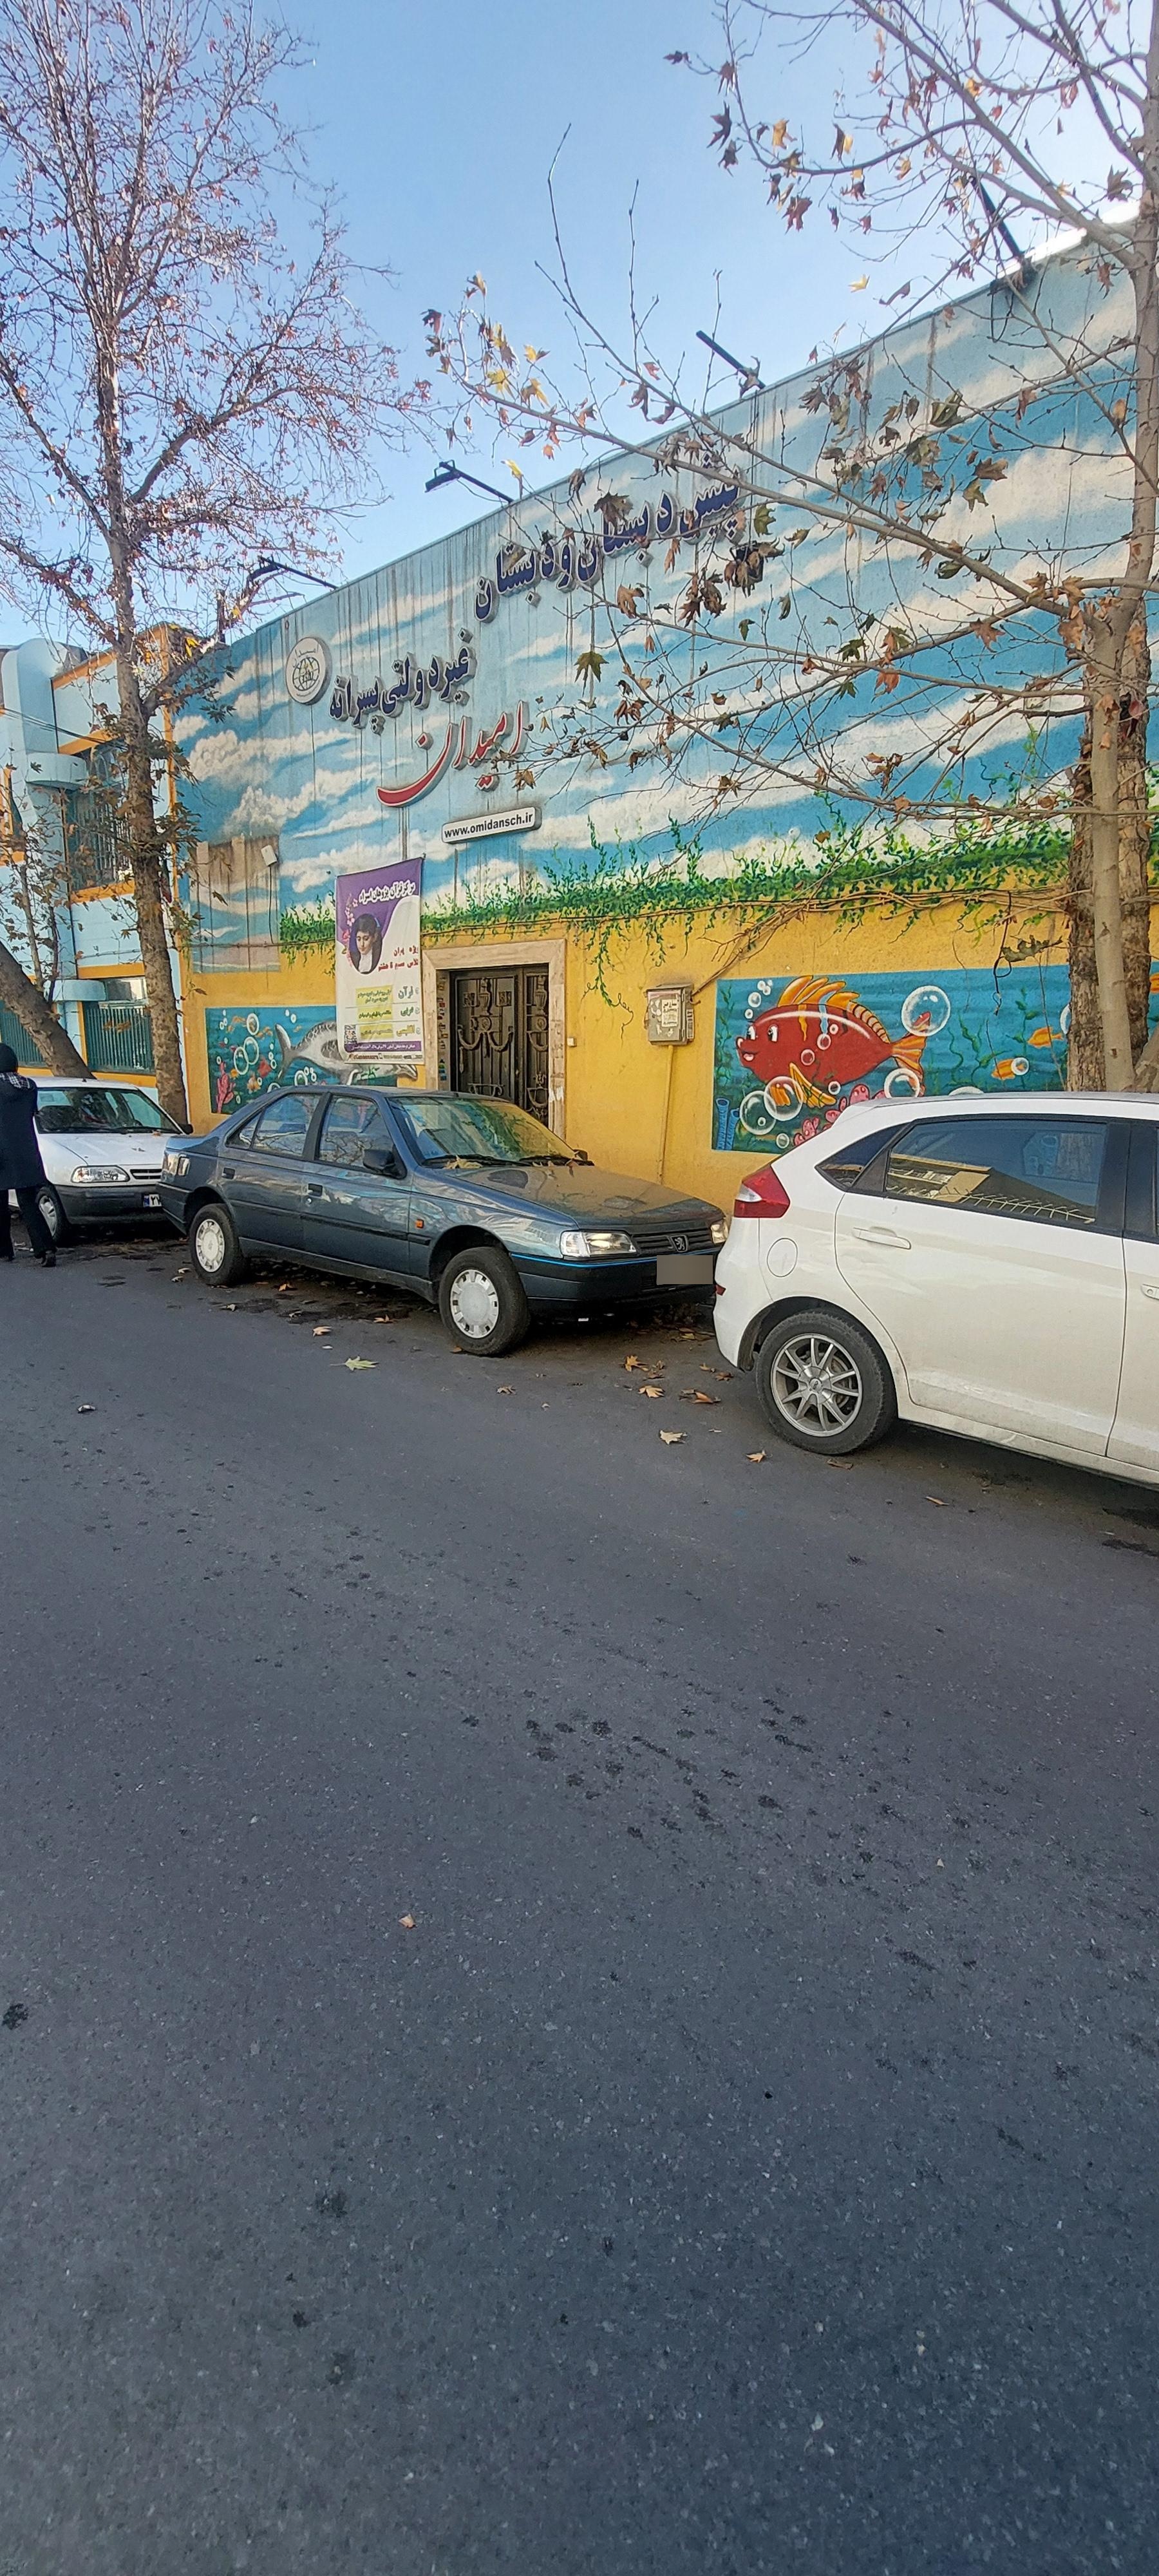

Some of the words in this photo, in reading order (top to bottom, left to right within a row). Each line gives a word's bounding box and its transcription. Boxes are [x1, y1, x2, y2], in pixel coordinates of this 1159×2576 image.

[679, 451, 740, 542] پیش
[557, 542, 572, 590] و
[380, 652, 440, 716] دولتی
[439, 627, 471, 703] غیر
[329, 674, 381, 735] پسرانه
[377, 700, 526, 806] امیدان
[444, 811, 533, 838] www.omidansch.ir
